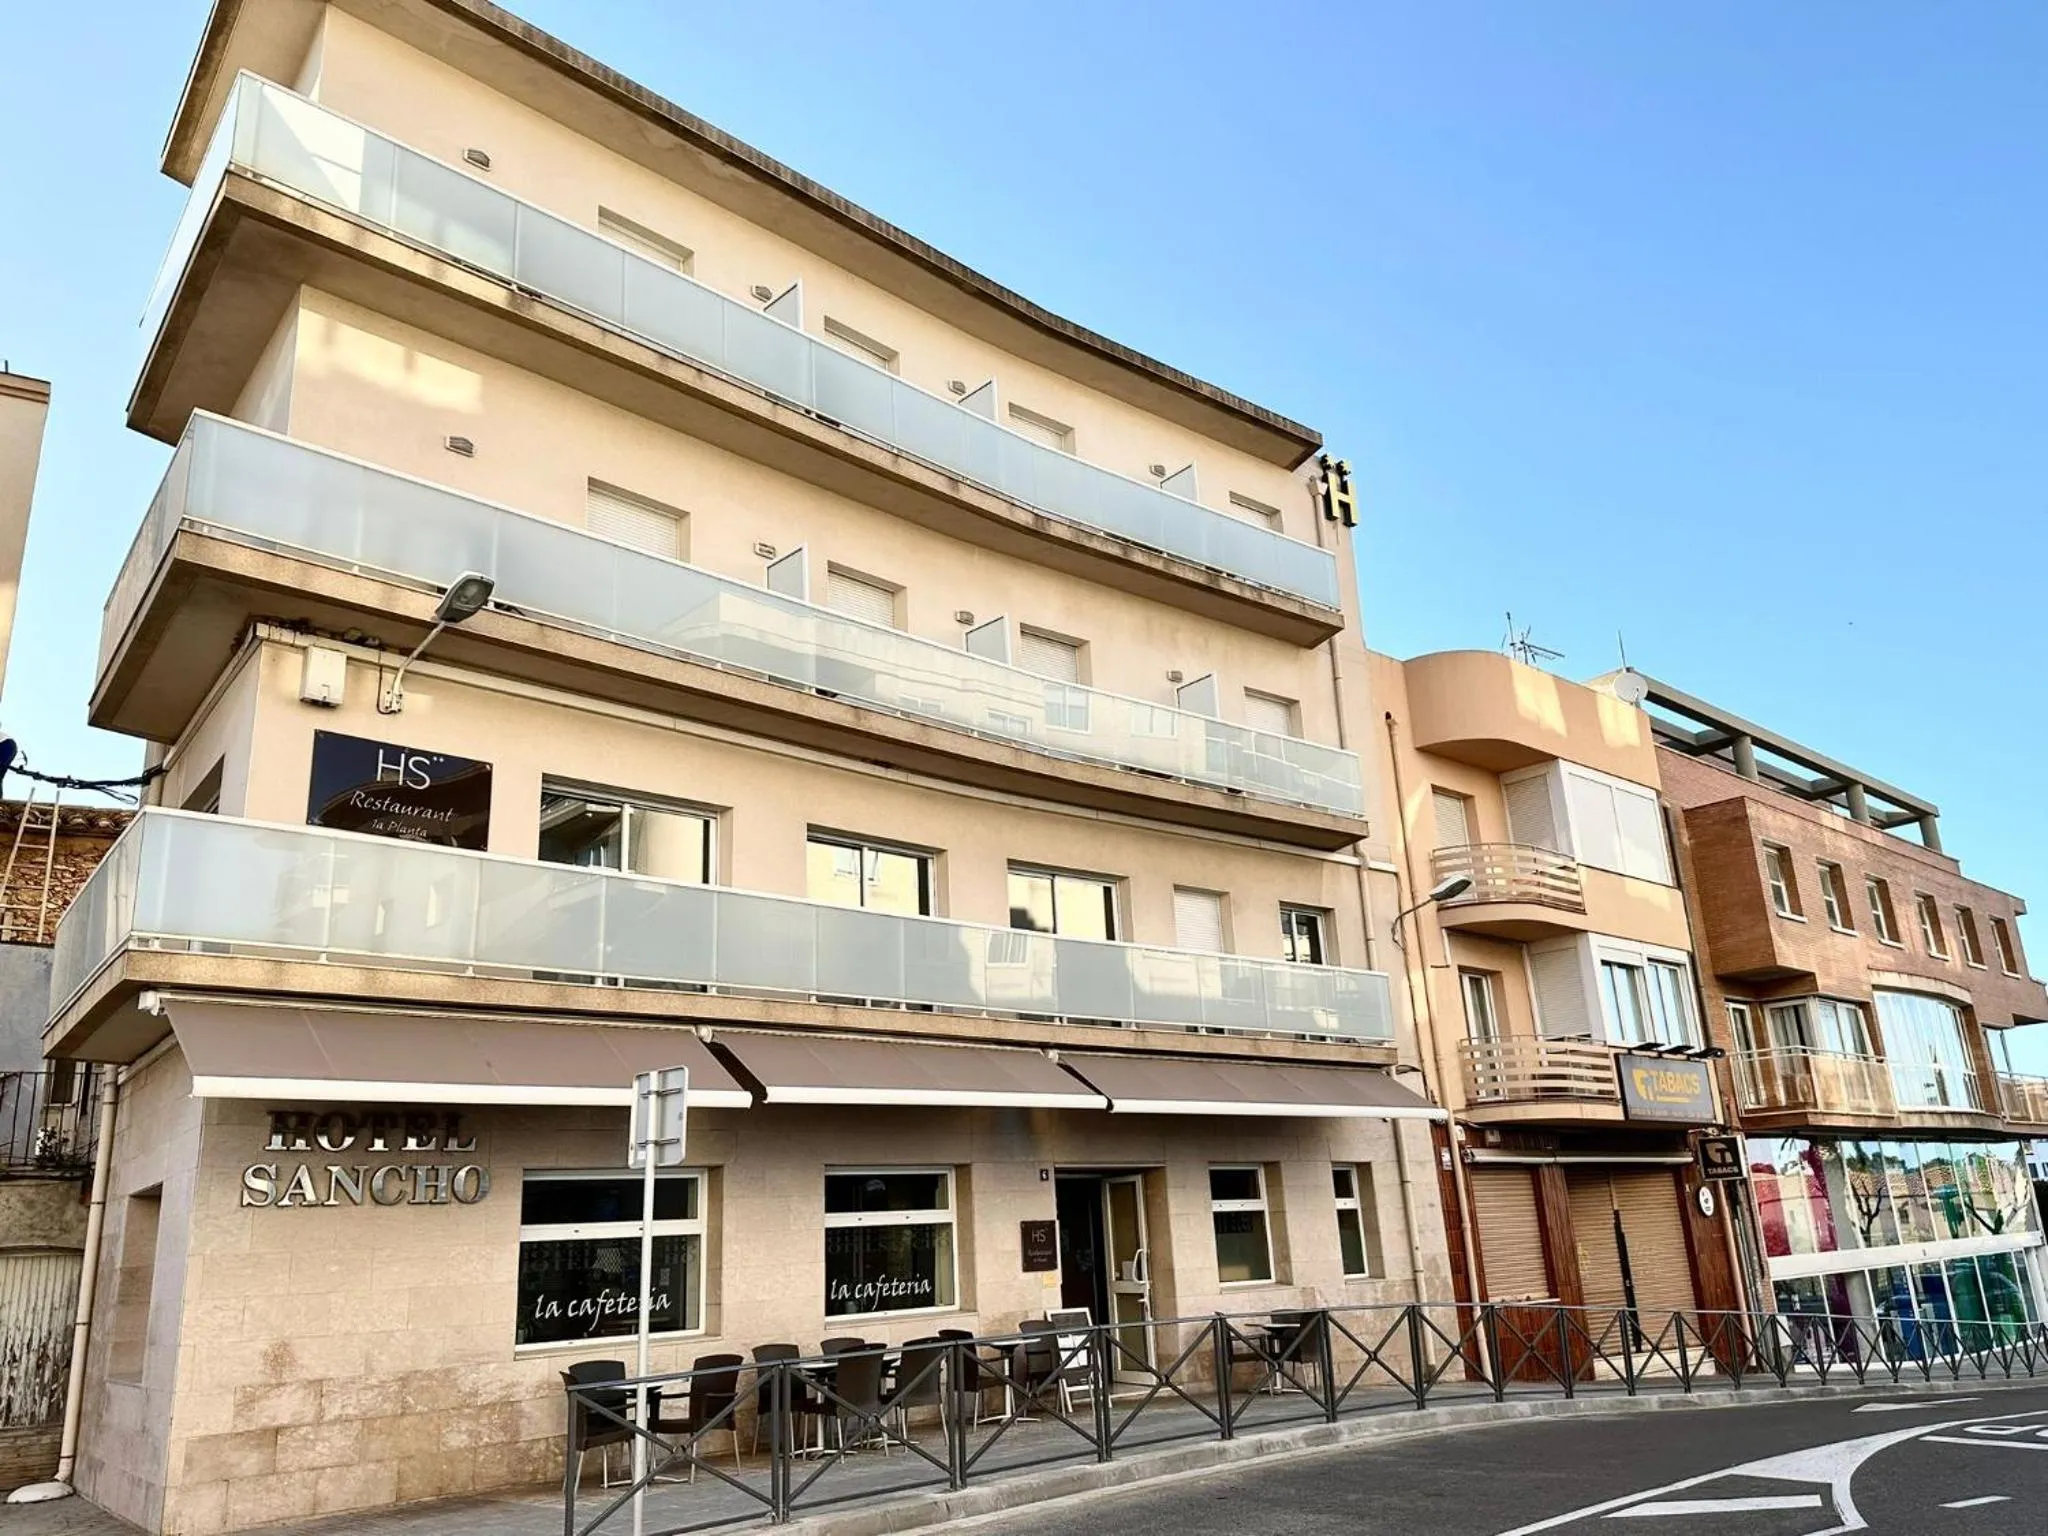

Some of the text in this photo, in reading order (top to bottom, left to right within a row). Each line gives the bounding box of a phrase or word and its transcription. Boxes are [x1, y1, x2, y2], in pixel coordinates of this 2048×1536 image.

[350, 790, 454, 822] Restaurant
[387, 820, 428, 838] Planta
[1648, 1070, 1701, 1096] TABACS
[264, 1110, 477, 1152] HOTEL
[241, 1163, 491, 1207] SANCHO
[1707, 1165, 1739, 1175] TABACS
[535, 1287, 672, 1332] la cafeteia
[831, 1273, 932, 1312] la cafeteria
